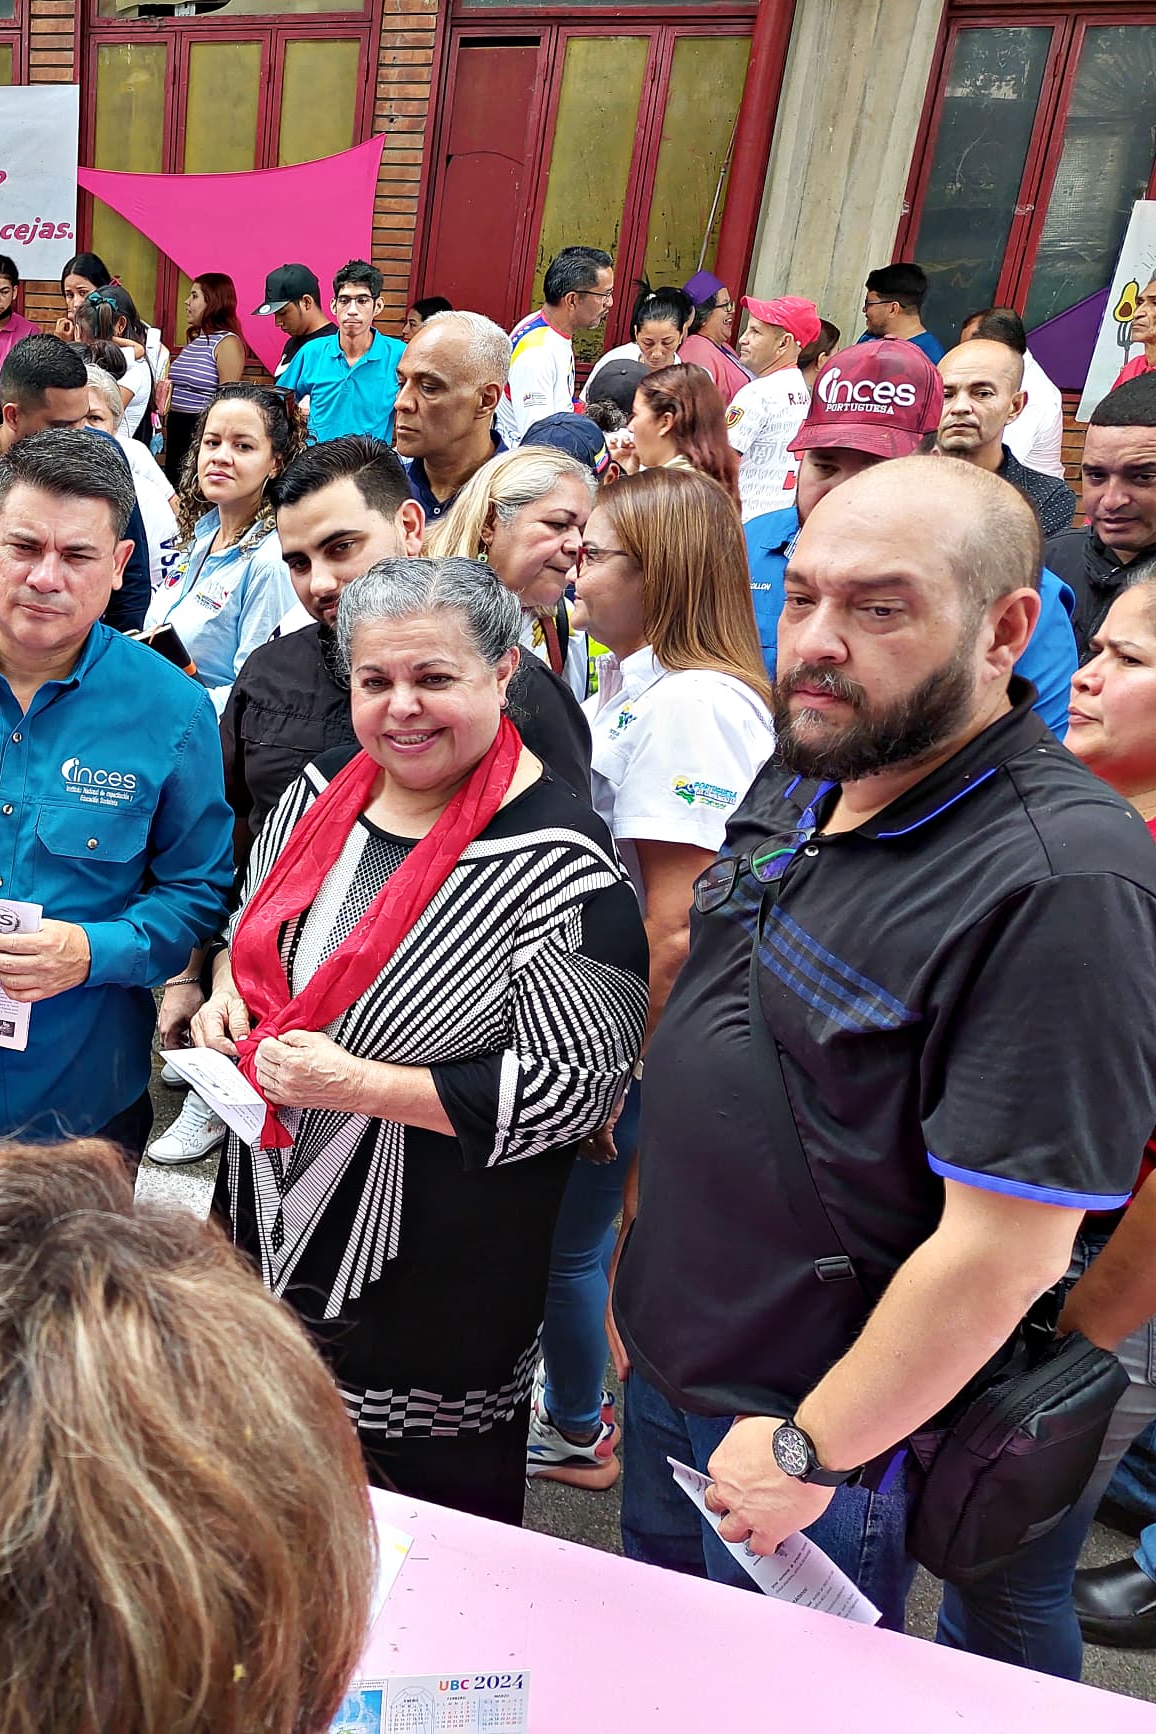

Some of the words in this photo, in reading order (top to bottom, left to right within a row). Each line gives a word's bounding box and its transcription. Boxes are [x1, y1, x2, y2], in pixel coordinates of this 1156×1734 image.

[0, 217, 74, 245] cejas.
[818, 367, 916, 407] inces
[825, 402, 895, 415] PORTUGUESA
[61, 757, 136, 790] inces
[439, 1679, 470, 1691] UBC
[474, 1674, 523, 1690] 2024
